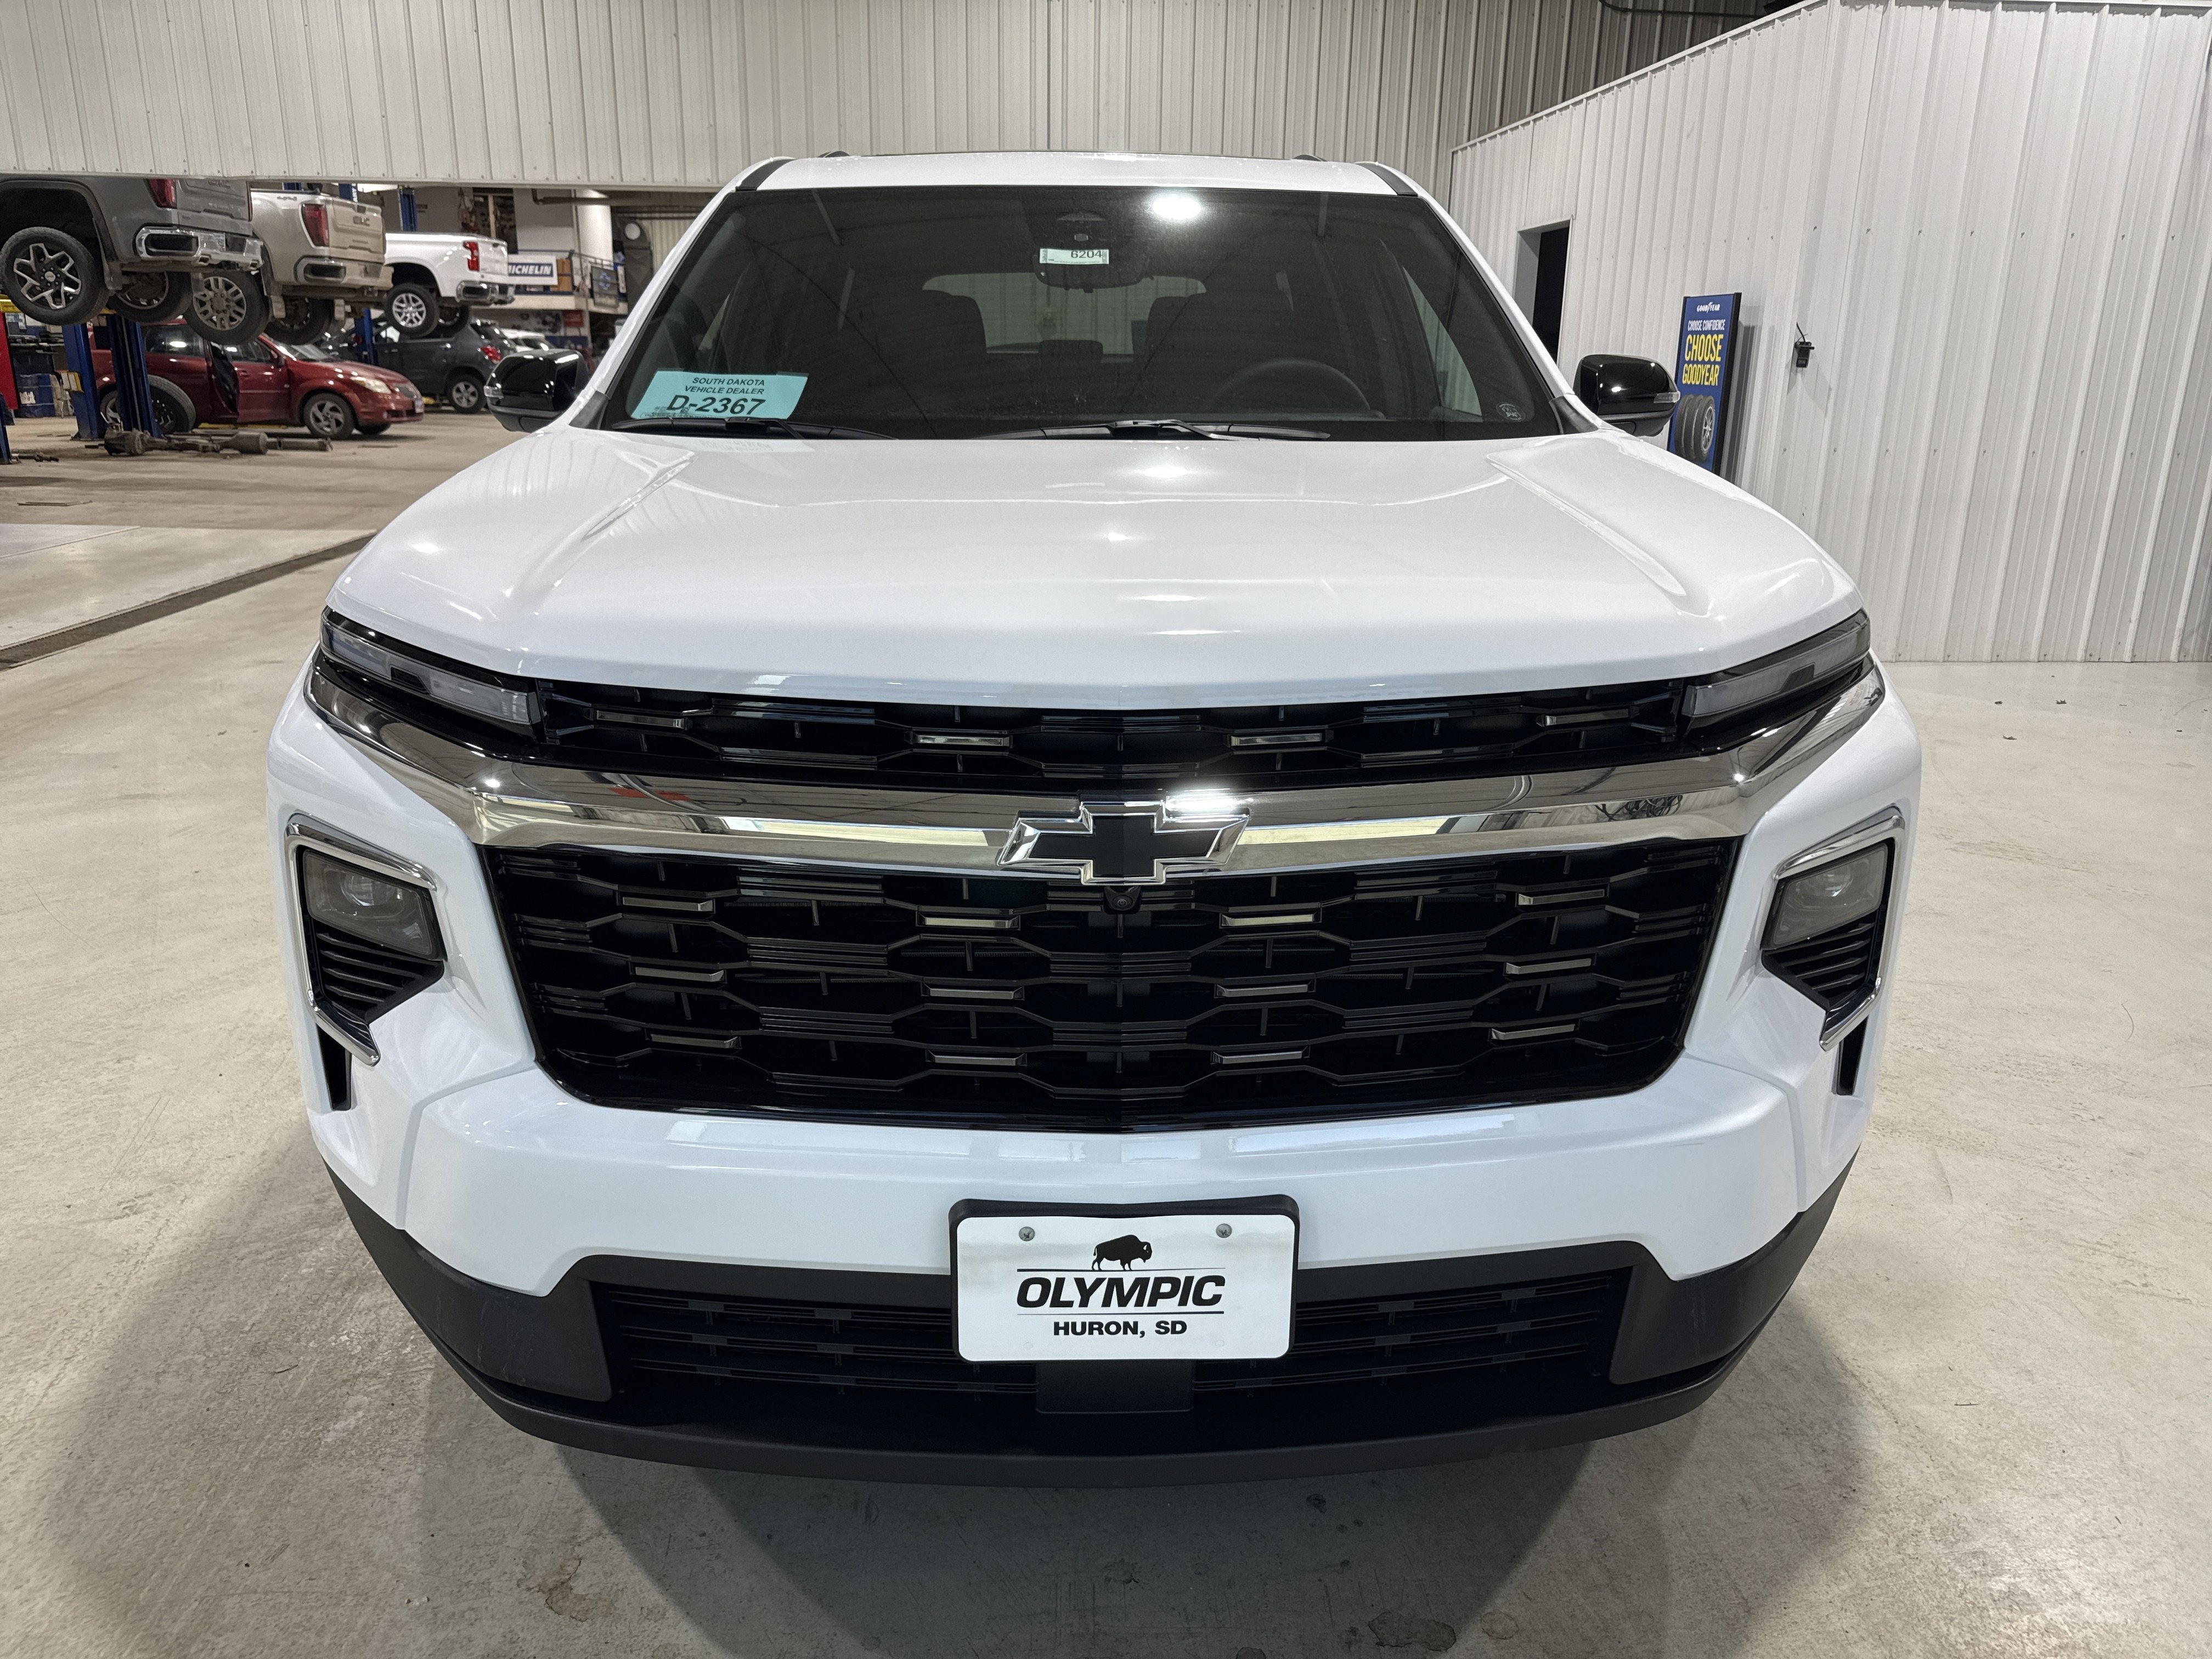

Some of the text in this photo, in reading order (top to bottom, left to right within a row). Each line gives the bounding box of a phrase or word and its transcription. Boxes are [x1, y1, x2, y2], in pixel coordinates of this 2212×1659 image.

[1071, 250, 1103, 258] 6204
[1696, 302, 1720, 314] GOODYEAR
[1688, 319, 1725, 331] CHOOSE CONFIDENCE
[1685, 334, 1724, 362] CHOOSE
[1682, 363, 1720, 386] GOODYEAR
[685, 385, 725, 394] VEHICLE
[667, 394, 766, 415] D-2367
[1017, 1275, 1226, 1308] OLYMPIC
[1053, 1321, 1187, 1338] HURON, SD
